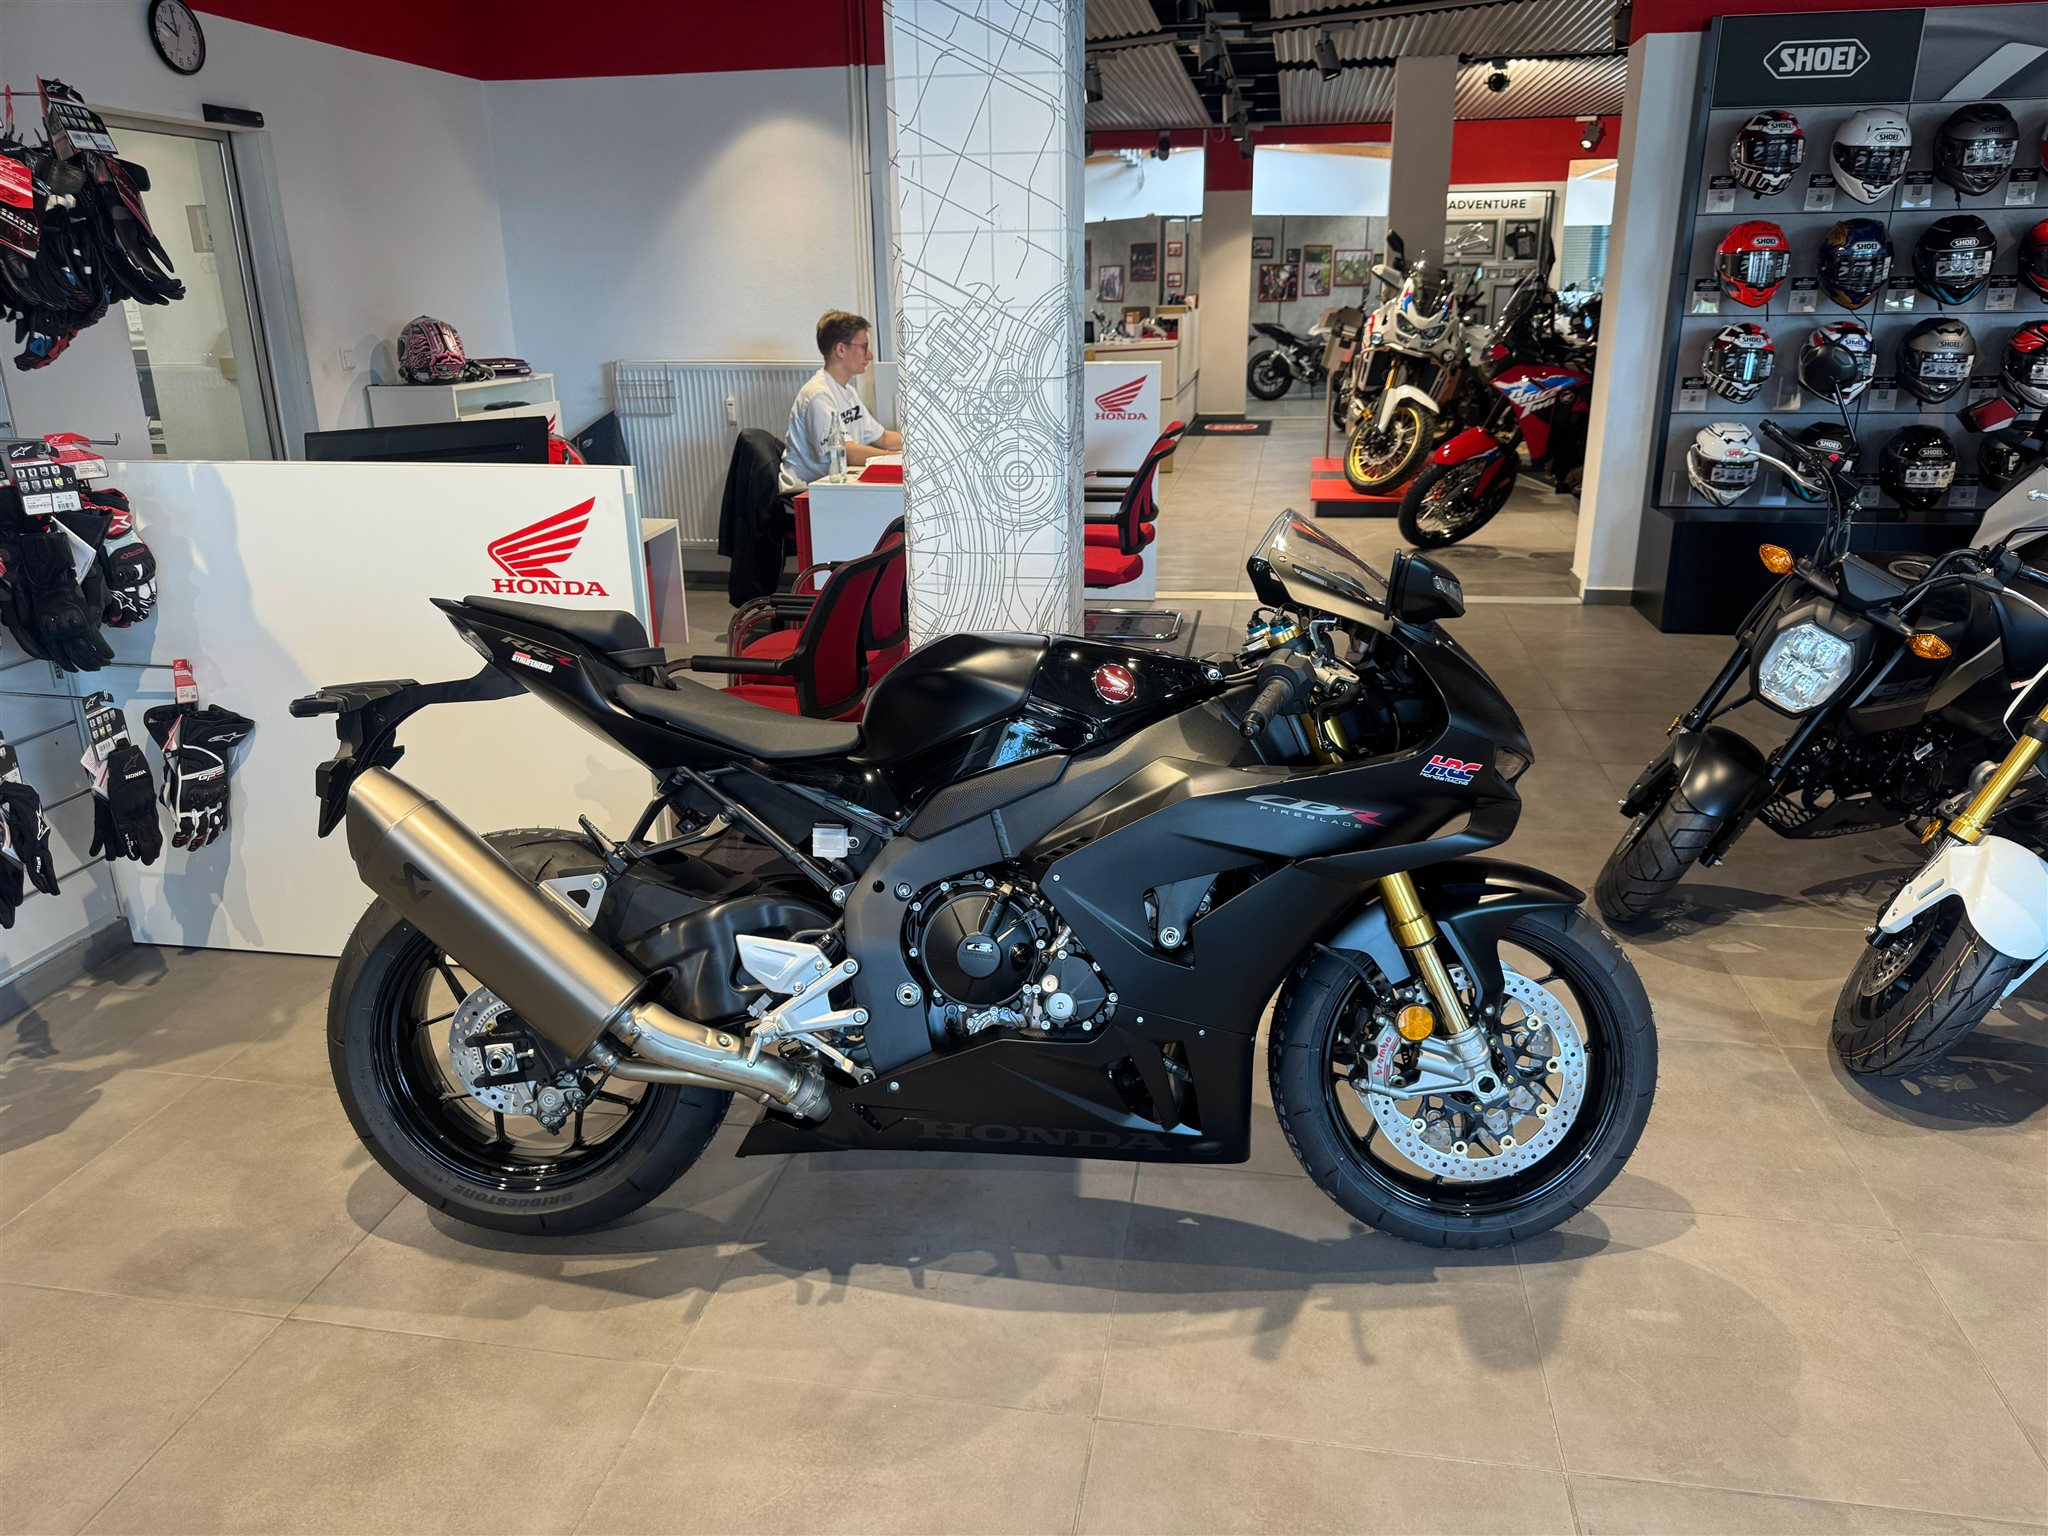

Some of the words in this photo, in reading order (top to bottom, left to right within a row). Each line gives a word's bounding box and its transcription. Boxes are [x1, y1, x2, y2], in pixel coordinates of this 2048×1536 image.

[1778, 45, 1857, 73] SHOEI
[1770, 120, 1793, 130] SHOEI
[1982, 126, 2005, 134] SHOEI
[1878, 133, 1900, 142] SHOEI
[1447, 198, 1527, 210] ADVENTURE
[1755, 237, 1777, 246] SHOEI
[1856, 242, 1878, 251] SHOEI
[1953, 239, 1977, 247] SHOEI
[1741, 336, 1763, 344] SHOEI
[1939, 340, 1961, 349] SHOEI
[1094, 412, 1148, 421] HONDA
[1819, 440, 1840, 449] SHOEI
[1921, 449, 1944, 457] SHOEI
[491, 578, 610, 597] HONDA
[1421, 754, 1484, 782] HRC
[125, 769, 147, 780] HONDA
[1244, 794, 1388, 828] CBR
[1259, 805, 1363, 830] FIREBLADE
[1374, 1036, 1393, 1077] brembo
[917, 1120, 1172, 1151] HONDA
[451, 1184, 575, 1209] BRIDGESTONE
